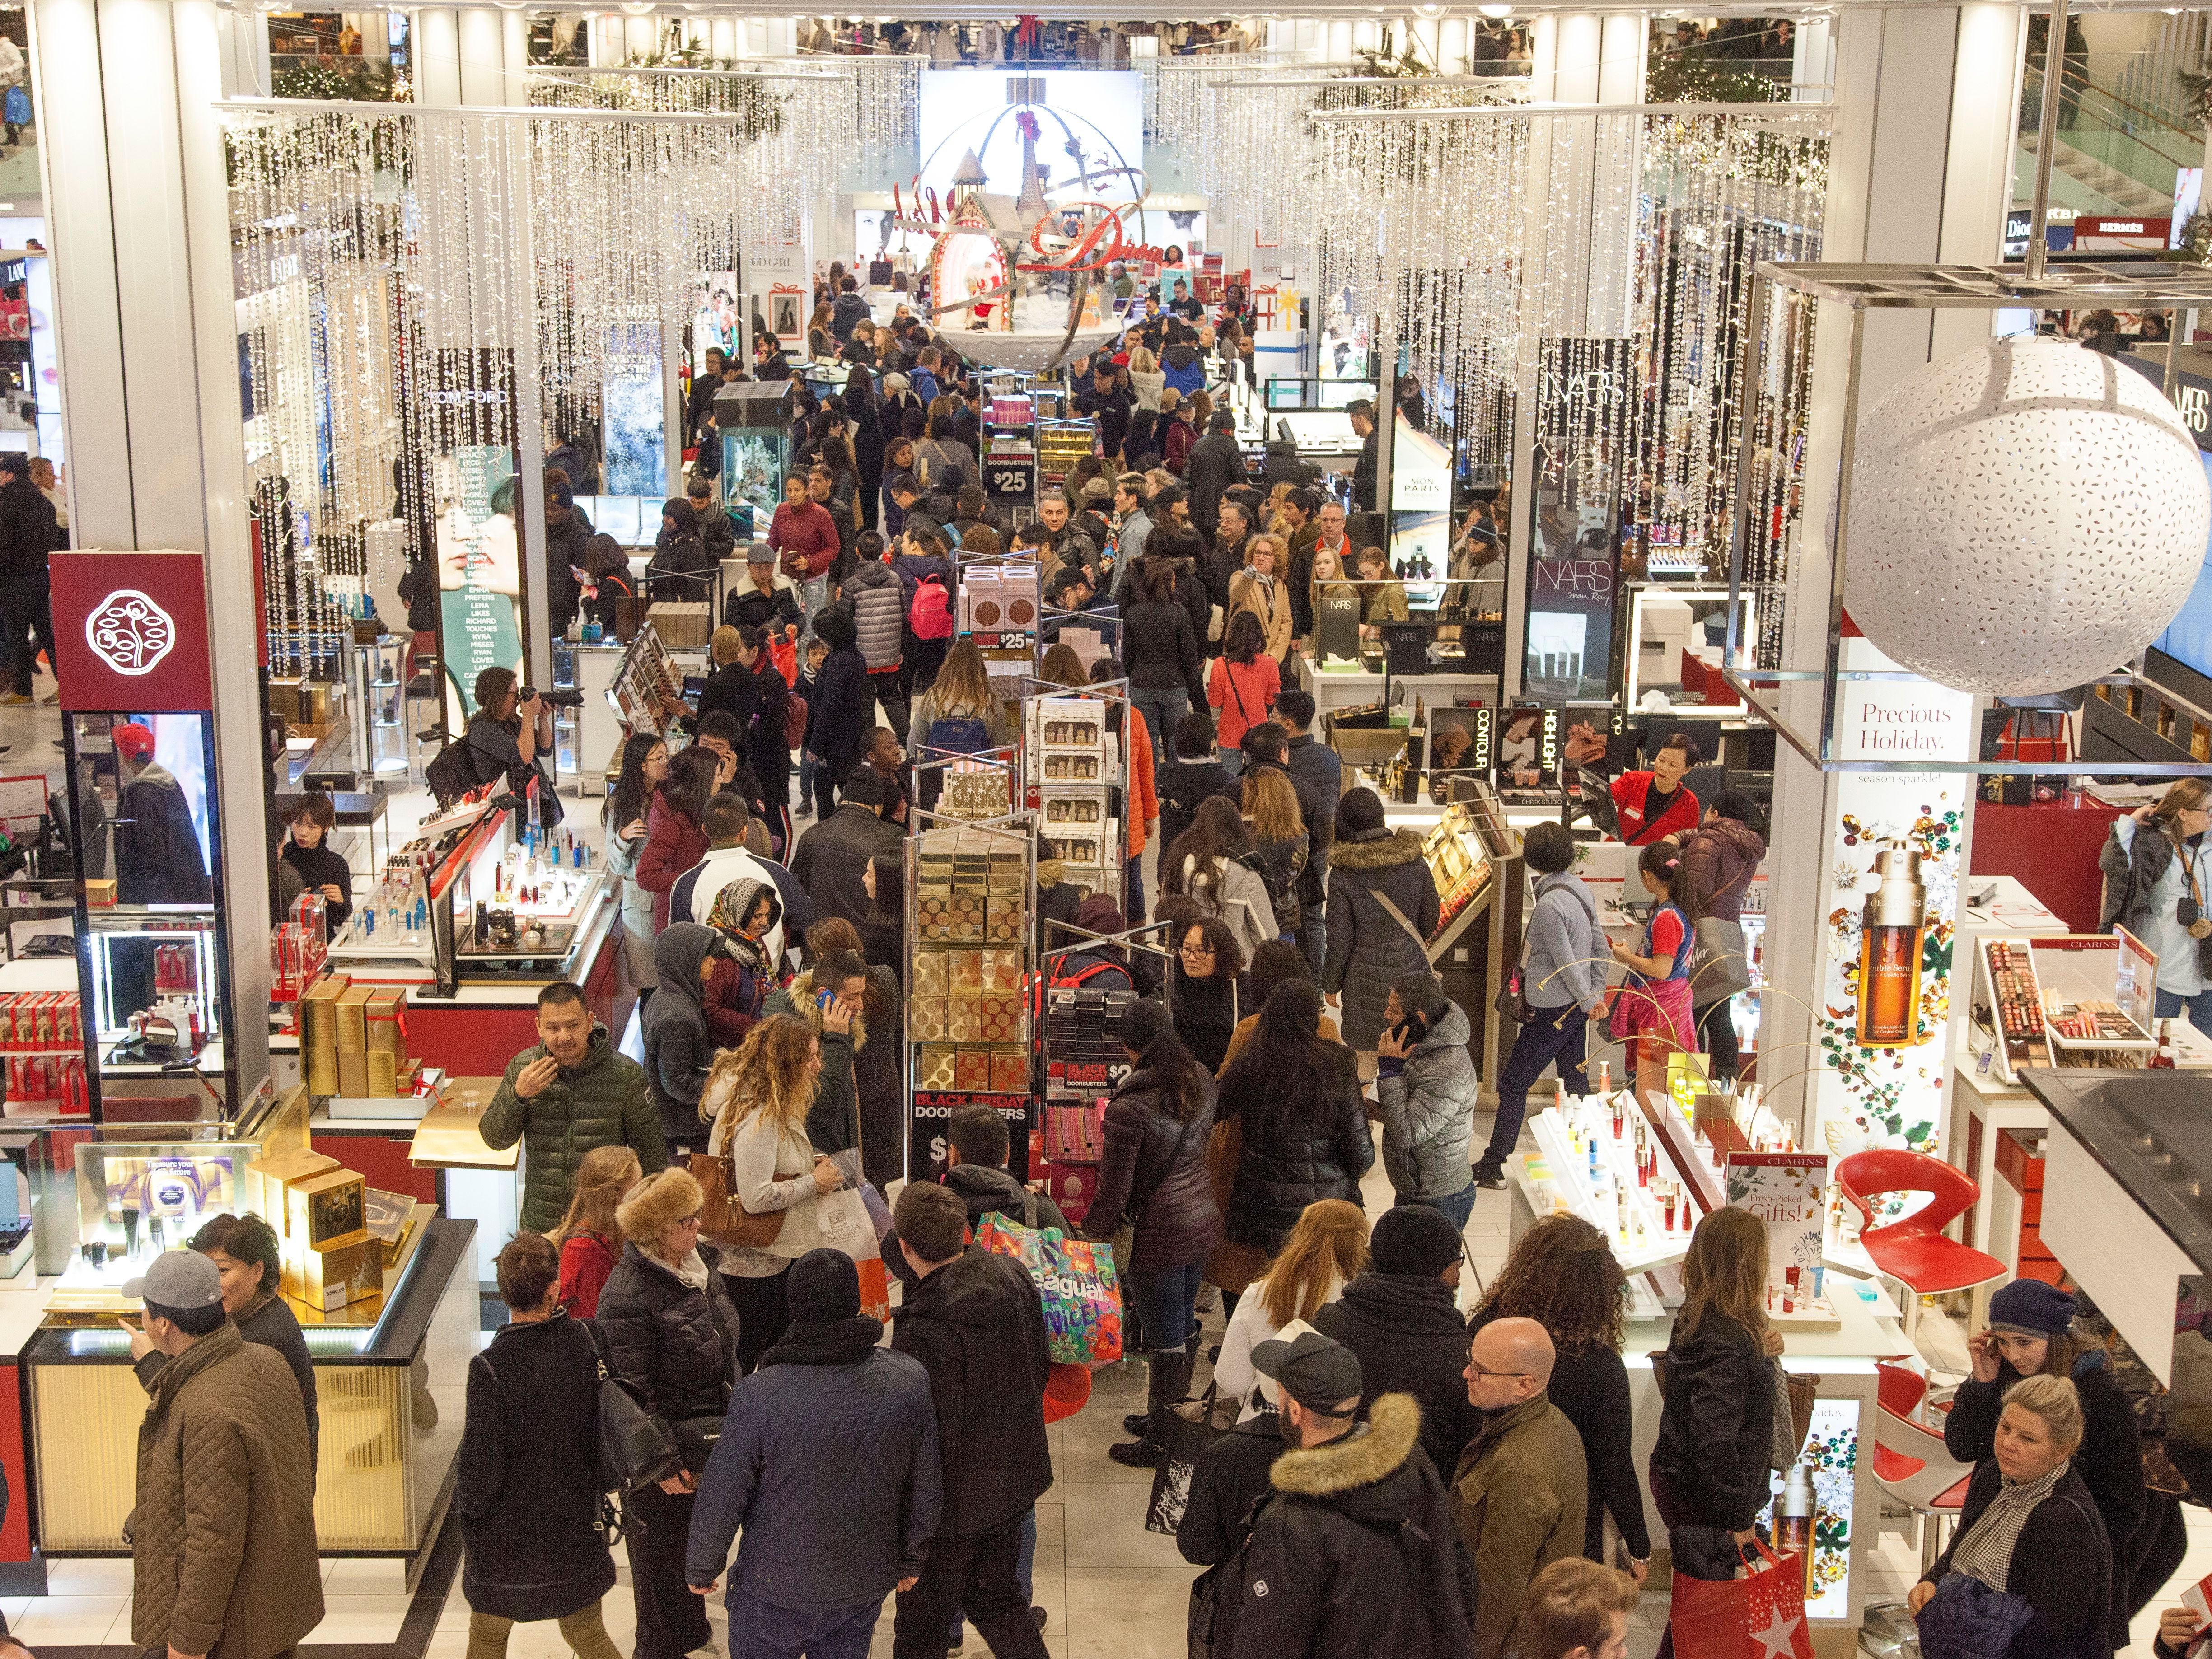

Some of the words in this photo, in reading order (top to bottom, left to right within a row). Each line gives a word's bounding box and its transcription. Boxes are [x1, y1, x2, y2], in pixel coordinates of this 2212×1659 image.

[1544, 371, 1624, 405] NARS
[2174, 383, 2209, 432] NARS
[994, 472, 1027, 491] $25
[1536, 559, 1611, 592] NARS
[1330, 600, 1351, 610] NARS
[1567, 591, 1589, 599] Man
[1591, 592, 1609, 606] Ray
[1001, 633, 1025, 649] $25
[1396, 632, 1417, 641] NARS
[1477, 632, 1498, 643] NARS
[1861, 703, 1951, 723] Precious
[1610, 710, 1623, 736] POP
[1476, 709, 1490, 768] CONTOUR
[1543, 709, 1557, 771] HIGHLIGHT
[1861, 730, 1944, 756] Holiday.
[1899, 773, 1941, 785] sparkle!
[1691, 947, 1709, 969] ylor
[2135, 946, 2151, 963] CLARINS
[1067, 1064, 1106, 1073] BLACK
[1110, 1065, 1132, 1086] $2
[915, 1094, 967, 1106] BLACK
[972, 1095, 1026, 1108] FRIDAY
[915, 1106, 1026, 1120] DOOERS
[1768, 1157, 1823, 1166] CLARINS
[169, 1168, 191, 1177] future
[1750, 1194, 1802, 1203] Fresh-Picked
[1749, 1203, 1801, 1223] Gifts!
[820, 1223, 861, 1238] MAGNOLIA
[827, 1231, 856, 1243] BAKERY
[326, 1287, 345, 1297] $280.00
[1812, 1406, 1846, 1421] oliday.
